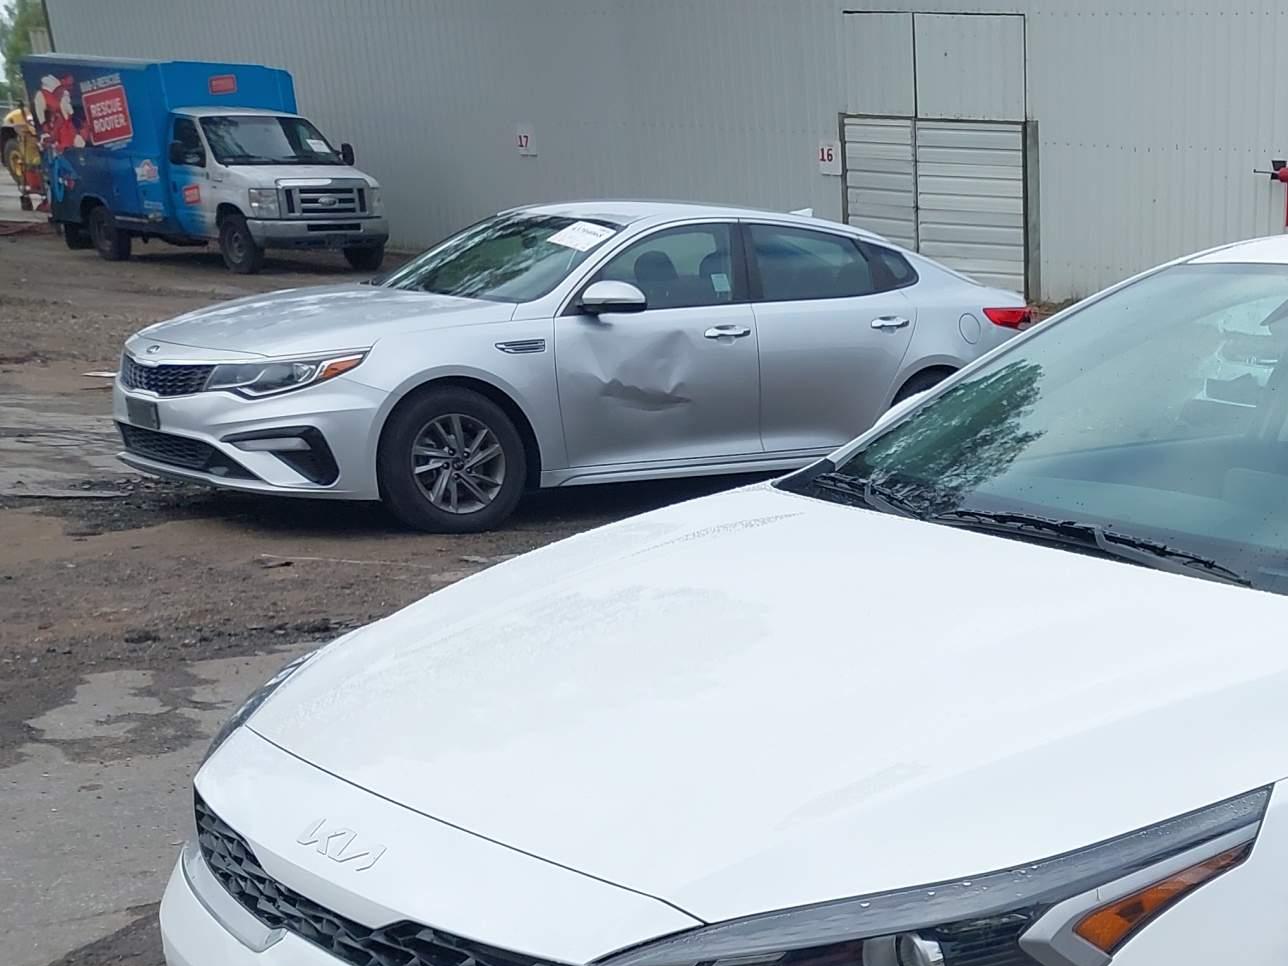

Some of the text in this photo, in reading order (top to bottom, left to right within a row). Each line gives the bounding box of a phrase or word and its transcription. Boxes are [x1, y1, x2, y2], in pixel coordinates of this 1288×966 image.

[89, 97, 123, 118] RESCUE
[518, 134, 529, 148] 17
[820, 147, 833, 162] 16
[295, 816, 388, 873] KIA
